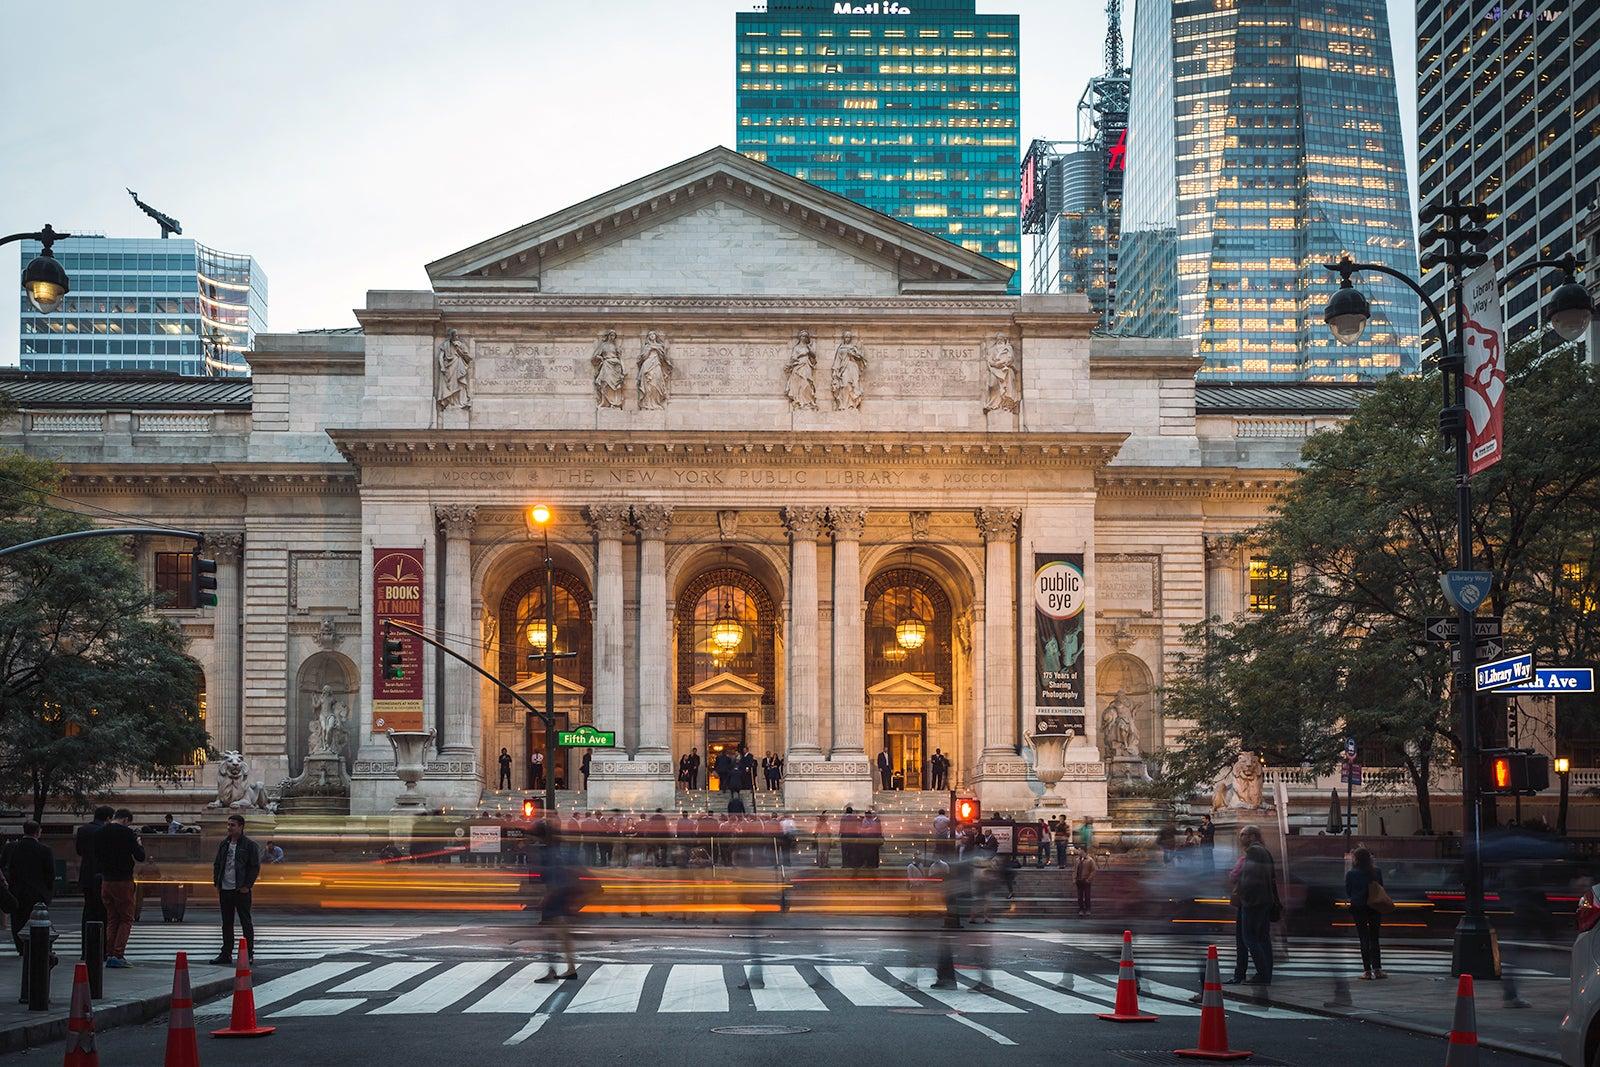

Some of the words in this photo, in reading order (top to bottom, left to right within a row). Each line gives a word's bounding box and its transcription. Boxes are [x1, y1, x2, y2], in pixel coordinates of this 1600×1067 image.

[833, 1, 911, 14] MetLife
[1472, 278, 1495, 299] Library
[481, 346, 501, 356] THE
[507, 346, 540, 356] ASTOR
[544, 346, 588, 356] LIBRARY
[701, 347, 735, 357] LENOX
[740, 347, 781, 358] LIBRARY
[869, 348, 889, 358] THE
[897, 348, 934, 359] TILDEN
[942, 348, 975, 359] TRUST
[442, 471, 514, 481] MDCCCXCV
[555, 469, 594, 483] THE
[608, 469, 657, 483] NEW
[674, 470, 724, 484] YORK
[740, 470, 807, 484] PUBLIC
[825, 470, 904, 484] LIBRARY
[1041, 571, 1079, 593] public
[386, 585, 420, 600] BOOKS
[377, 600, 388, 613] AT
[391, 600, 419, 613] NOON
[1049, 593, 1071, 611] eye
[1436, 624, 1456, 634] ONE
[1054, 671, 1070, 680] Years
[1071, 671, 1078, 679] of
[1485, 668, 1512, 684] Library
[1513, 662, 1531, 678] Way
[1048, 681, 1072, 690] Sharing
[1548, 674, 1577, 688] Ave
[1042, 690, 1079, 700] Photography
[564, 734, 586, 744] Fifth
[588, 735, 607, 744] Ave
